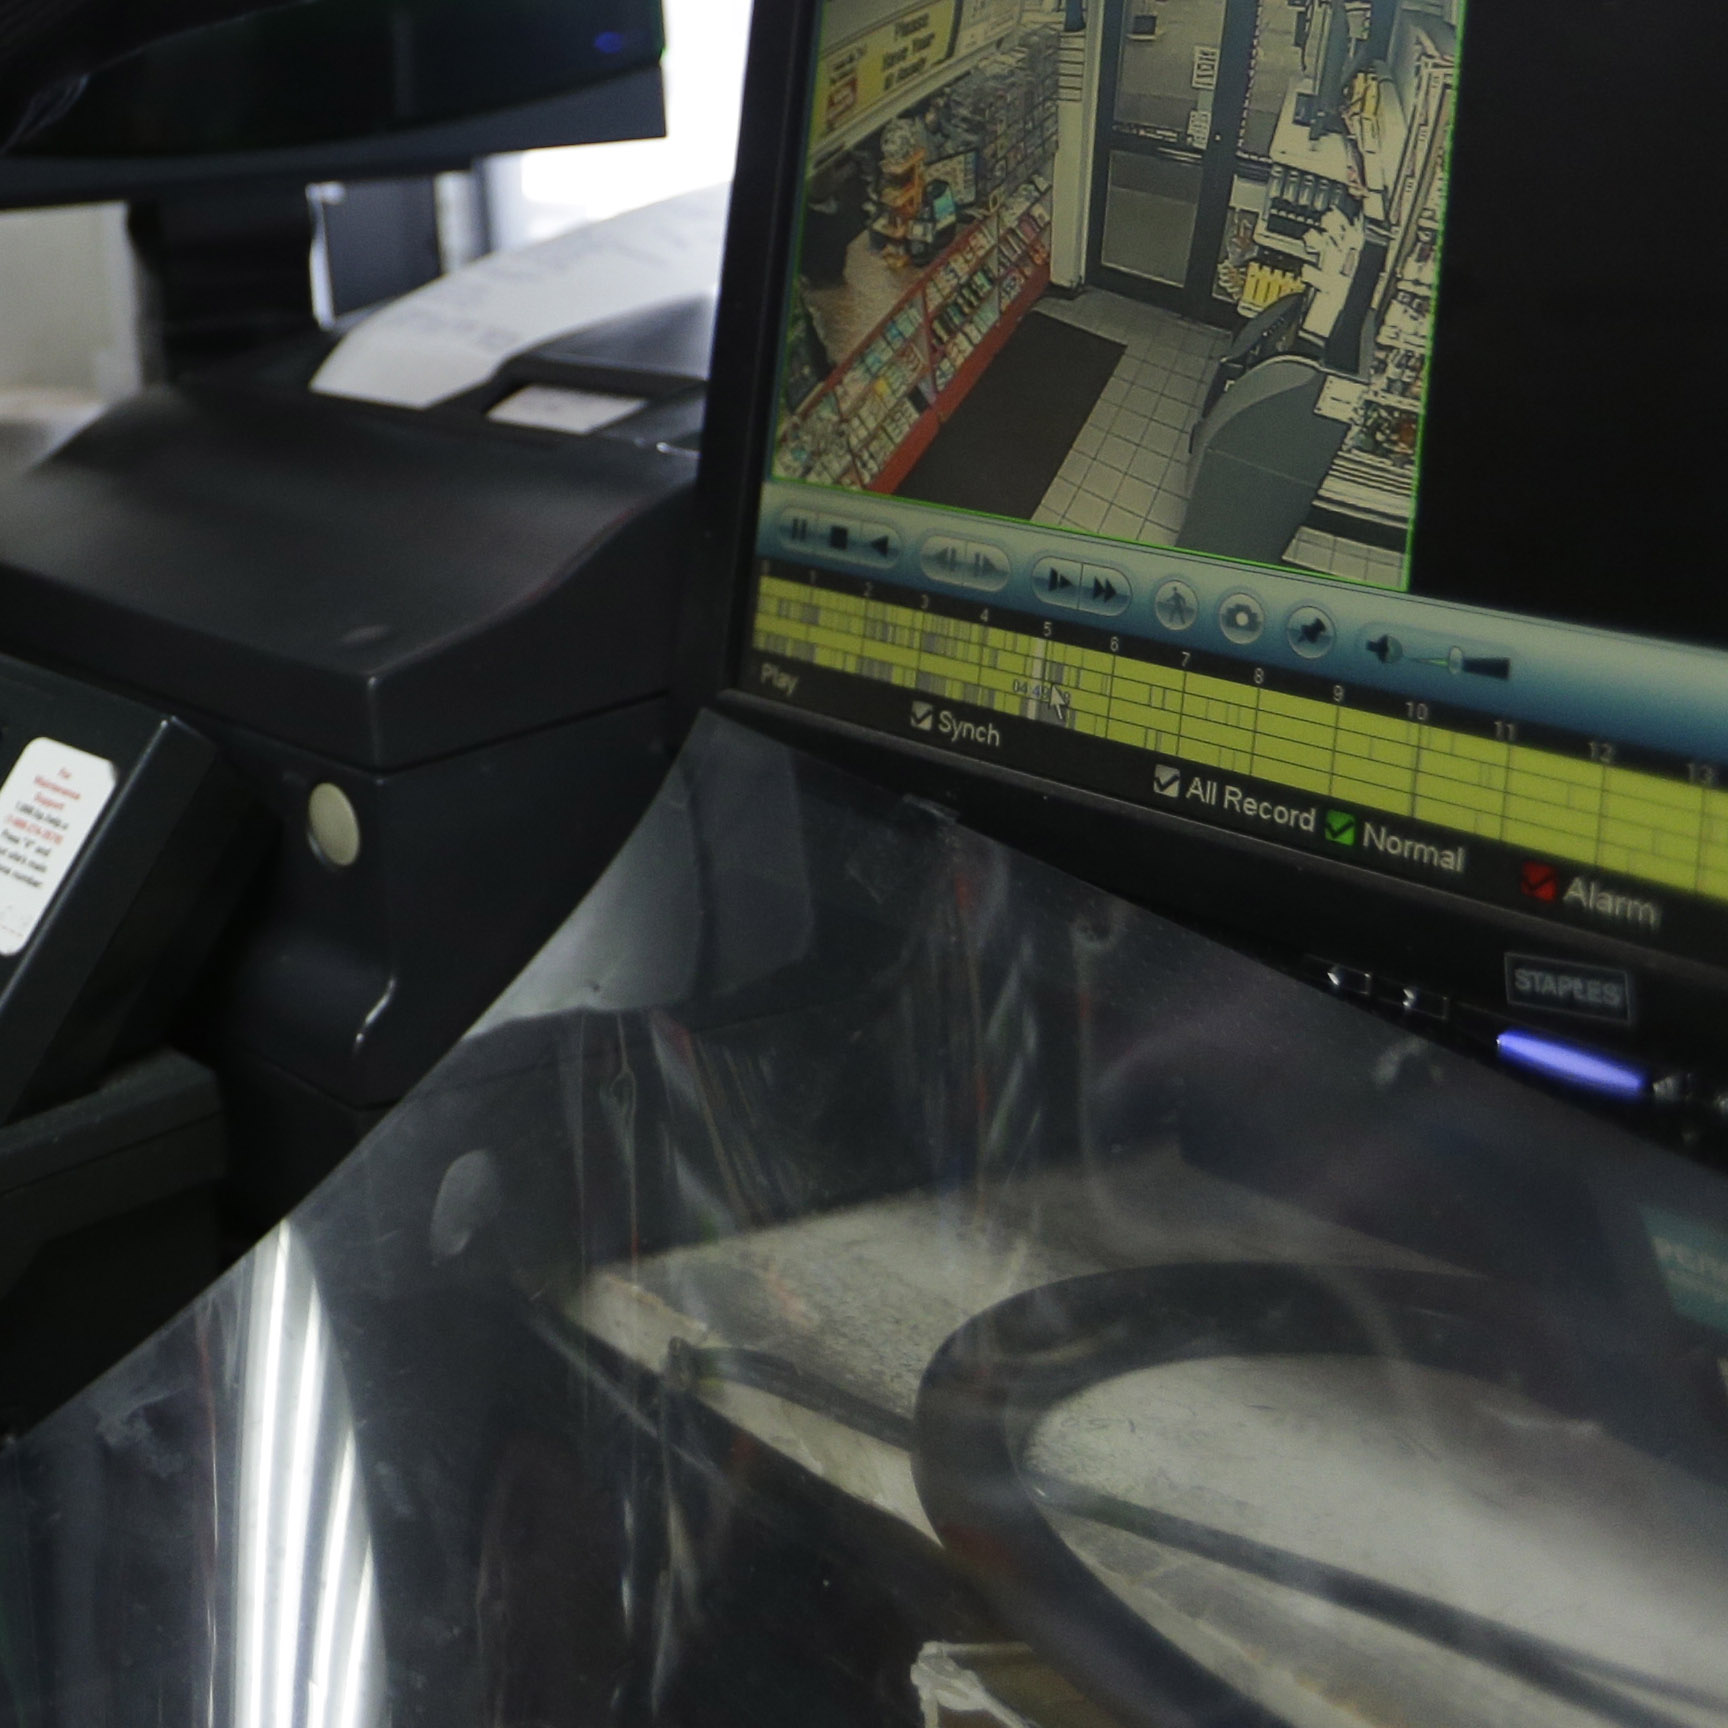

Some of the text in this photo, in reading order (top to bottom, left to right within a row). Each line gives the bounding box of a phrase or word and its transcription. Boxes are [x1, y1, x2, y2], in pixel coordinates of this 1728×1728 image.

[1180, 650, 1192, 668] 7
[1253, 667, 1265, 685] 8
[1332, 684, 1344, 703] 9
[1404, 701, 1429, 721] 10
[938, 709, 1001, 748] Synch
[1184, 775, 1317, 833] All Record
[1361, 821, 1466, 873] Normal
[1562, 875, 1663, 929] Alarm
[1513, 967, 1624, 1009] STAPLES
